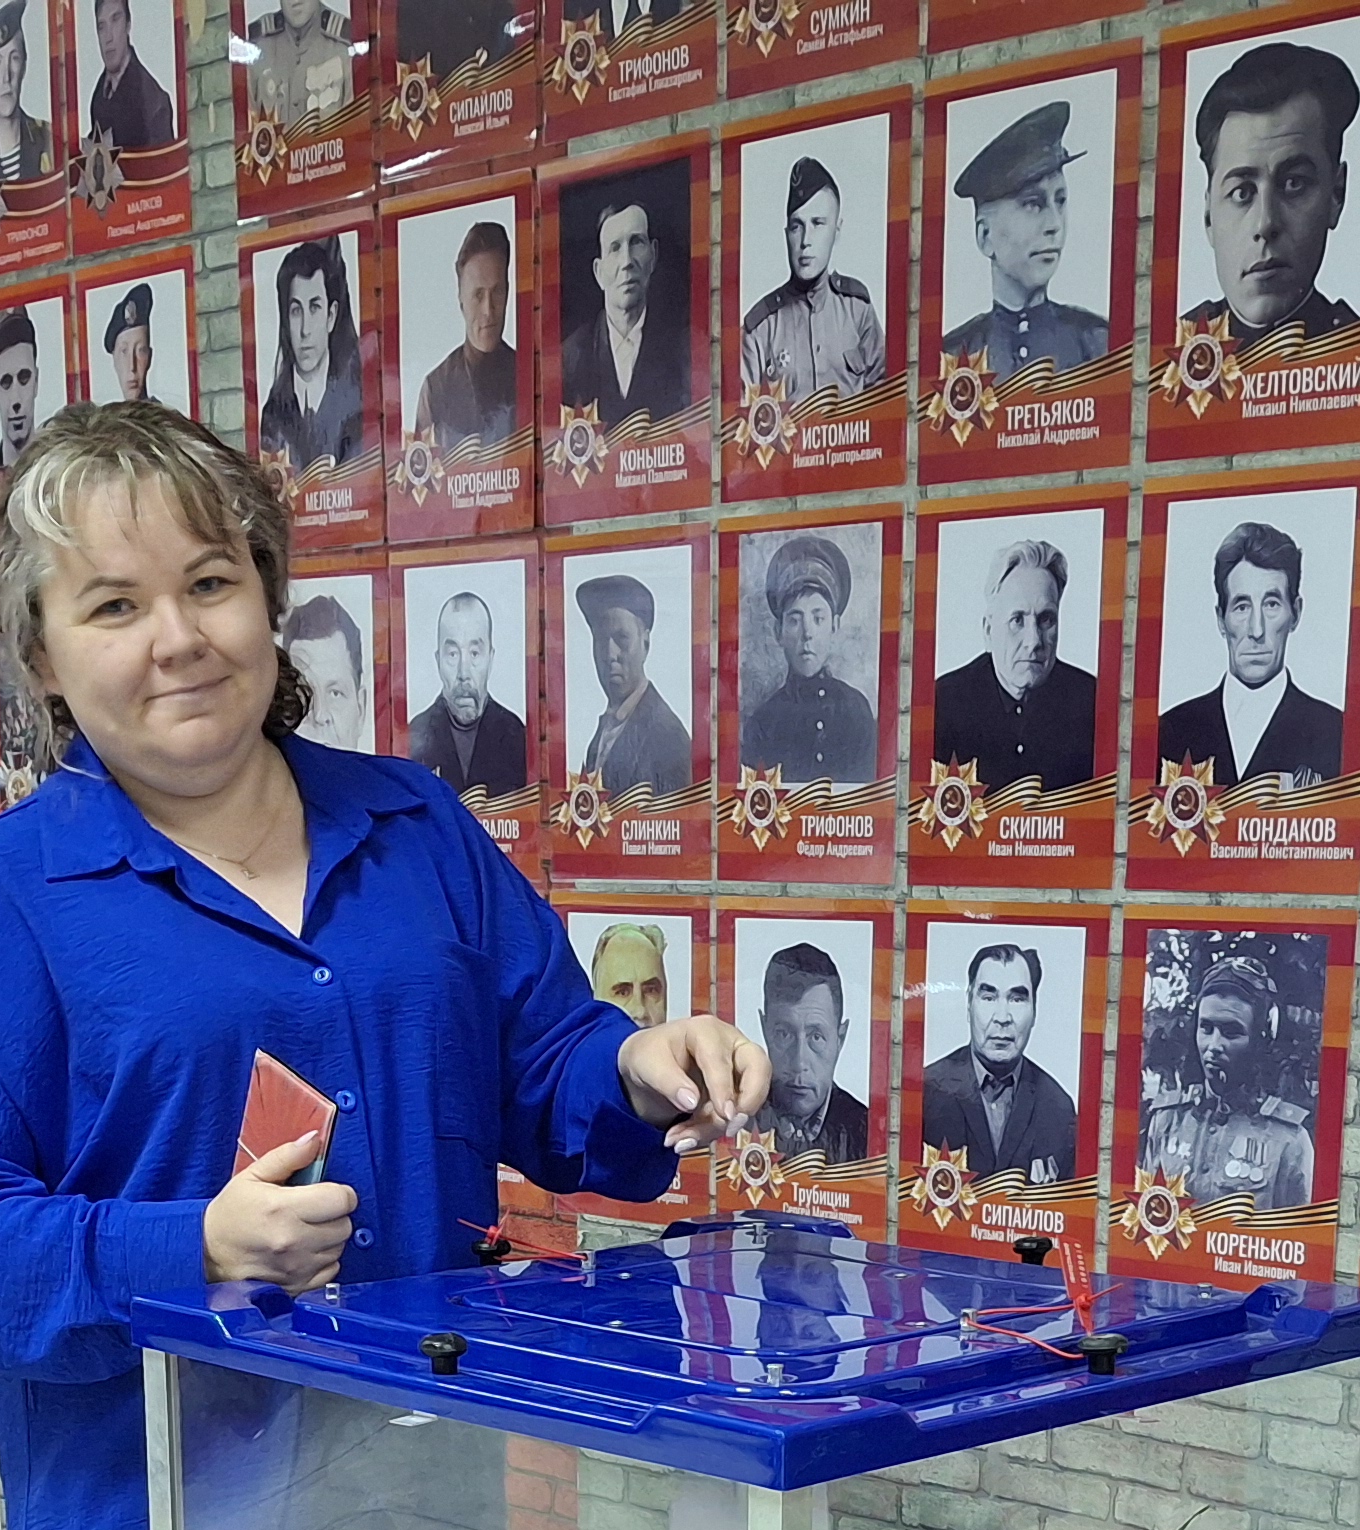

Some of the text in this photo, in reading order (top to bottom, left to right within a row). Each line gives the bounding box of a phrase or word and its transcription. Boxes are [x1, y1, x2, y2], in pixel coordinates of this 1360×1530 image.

[810, 0, 870, 36] СУМКИН
[618, 44, 690, 84] ТРИФОНОВ
[449, 88, 513, 124] СИПАЙЛОВ
[290, 138, 344, 172] МУХОРТОВ
[1005, 397, 1096, 431] ТРЕТЬЯКОВ
[1241, 397, 1286, 419] Михаил
[801, 420, 870, 450] ИСТОМИН
[996, 424, 1101, 449] Николай Андреевич
[619, 443, 685, 472] КОНЫШЕВ
[447, 467, 520, 497] КОРОБИНЦЕВ
[305, 488, 353, 513] МЕЛЕХИН
[621, 819, 681, 841] СЛИНКИН
[799, 814, 874, 839] ТРИФОНОВ
[999, 816, 1065, 840] СКИПИН
[1237, 817, 1337, 846] КОНДАКОВ
[987, 841, 1076, 858] Иван Николаевич
[1209, 842, 1354, 861] Василий Константинович
[791, 1181, 850, 1211] Трубицин
[970, 1223, 1004, 1242] Кузьма
[981, 1203, 1064, 1234] СИПАЙЛОВ
[1205, 1230, 1306, 1266] КОРЕНЬКОВ
[1214, 1256, 1297, 1280] Иван Иванович
